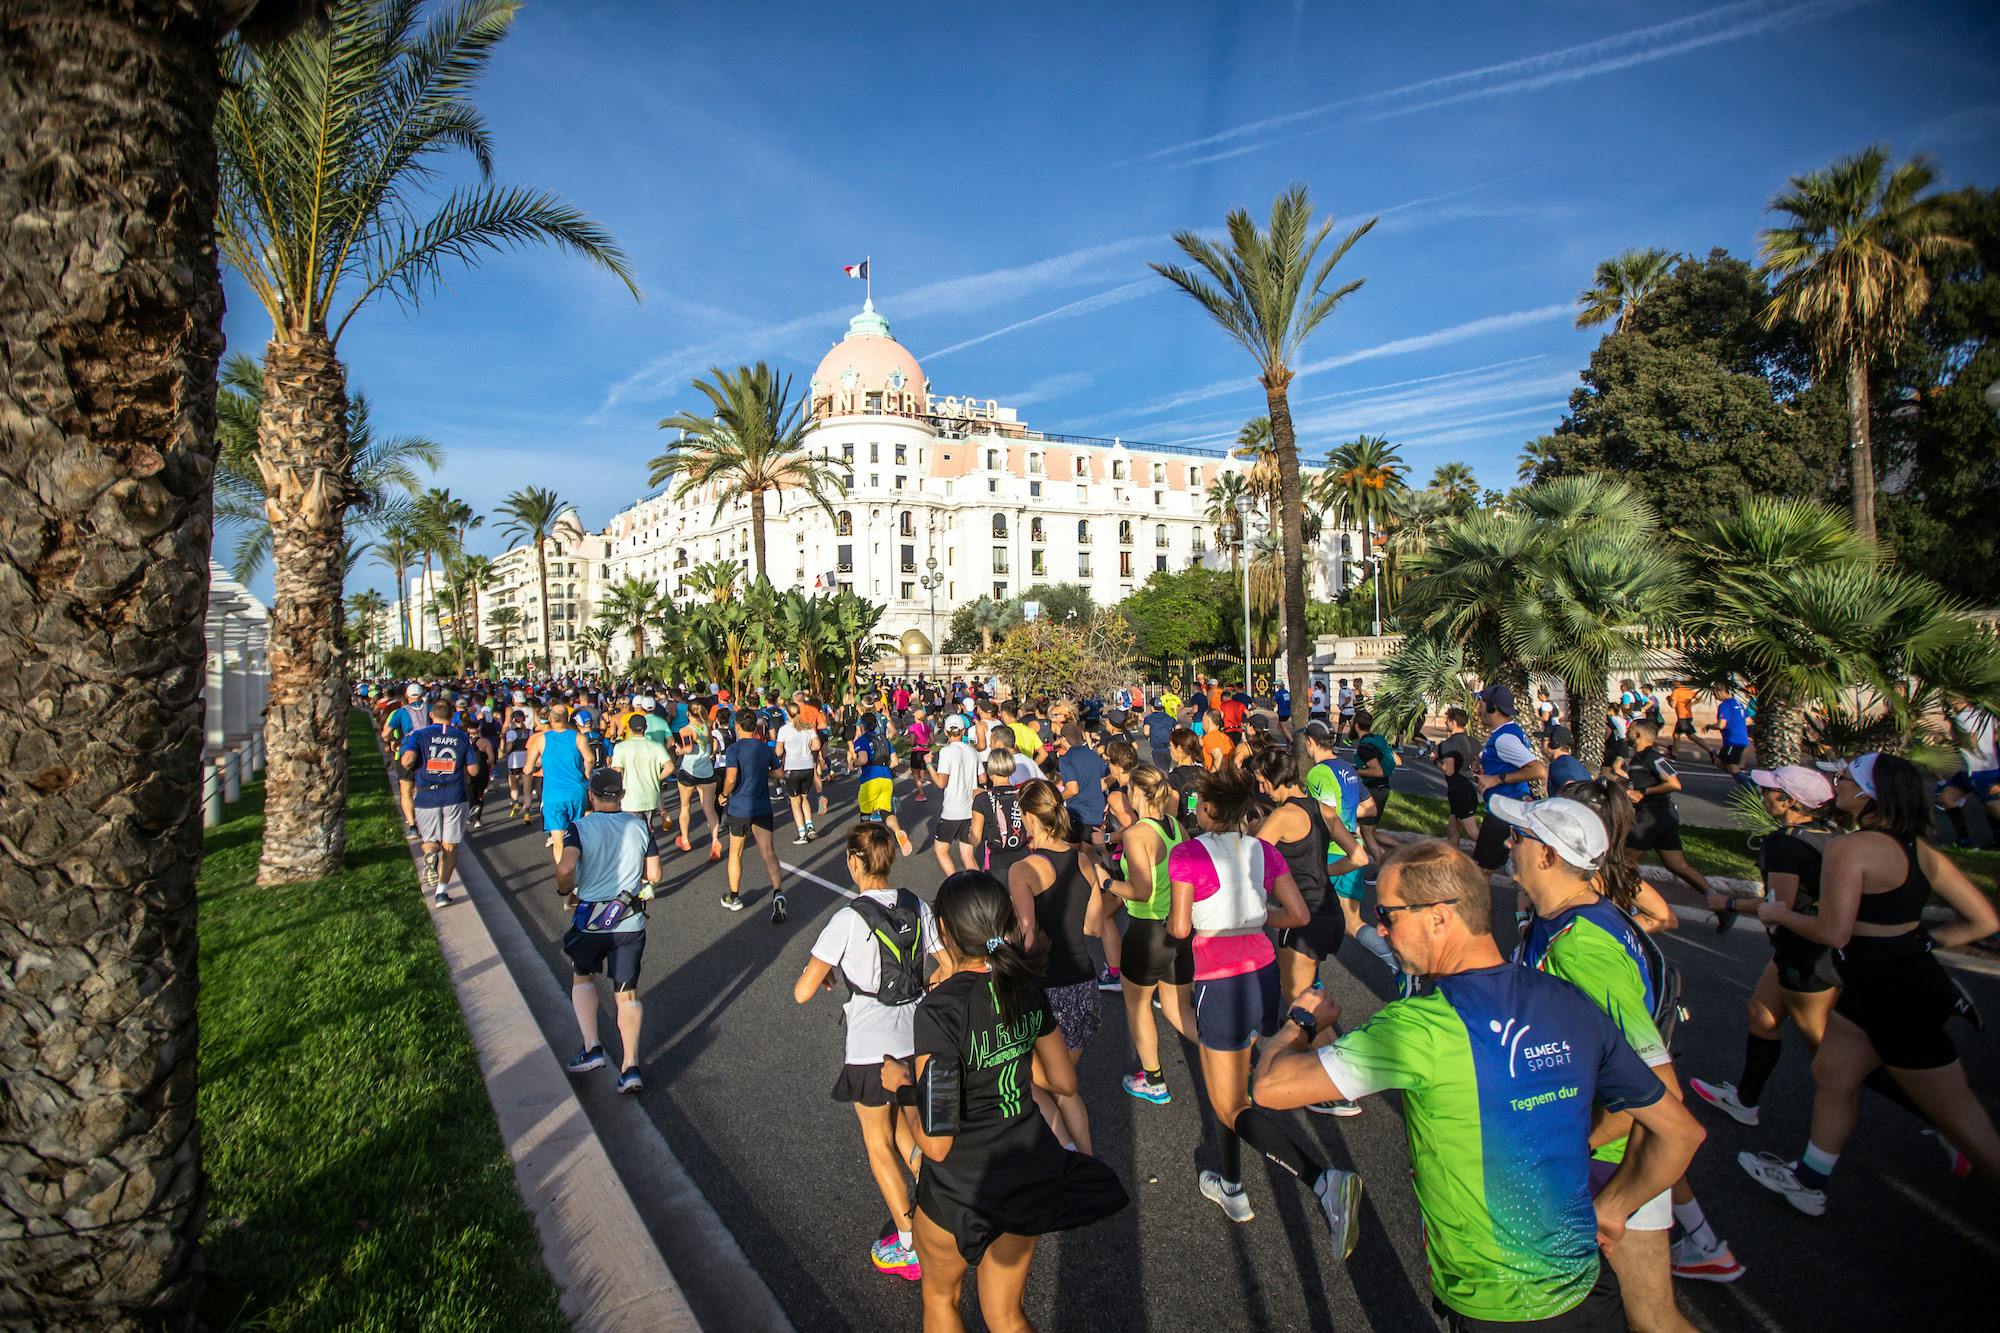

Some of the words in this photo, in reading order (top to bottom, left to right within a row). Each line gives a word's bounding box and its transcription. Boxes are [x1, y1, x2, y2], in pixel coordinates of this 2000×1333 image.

[838, 388, 998, 422] NEGRESCO
[1007, 800, 1022, 848] Oxsitis
[983, 1042, 1034, 1069] HERBAL
[1523, 1042, 1561, 1060] ELMEC
[1562, 1040, 1571, 1052] 4
[1527, 1053, 1572, 1072] SPORT
[1509, 1091, 1557, 1112] Tegnem
[1558, 1086, 1579, 1100] dur
